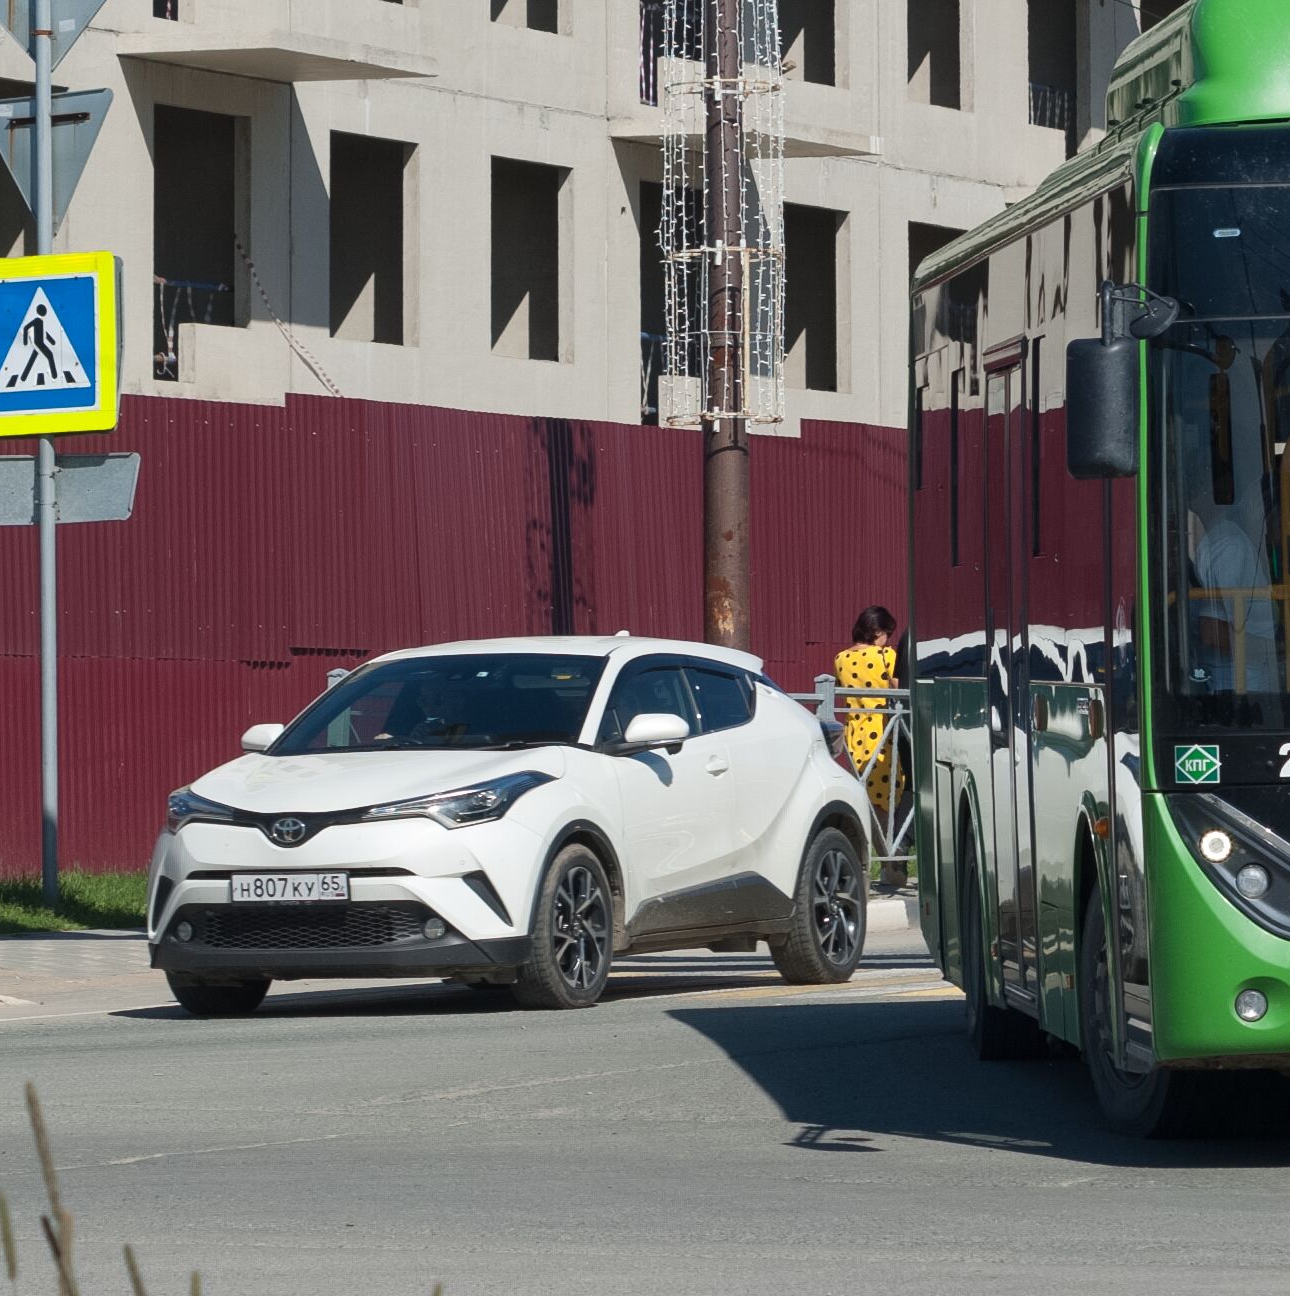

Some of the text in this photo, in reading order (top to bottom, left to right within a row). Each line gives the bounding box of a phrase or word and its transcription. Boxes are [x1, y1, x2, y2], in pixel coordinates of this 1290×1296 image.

[1184, 758, 1211, 773] КПГ
[239, 877, 316, 898] Н807КУ
[320, 875, 341, 892] 65
